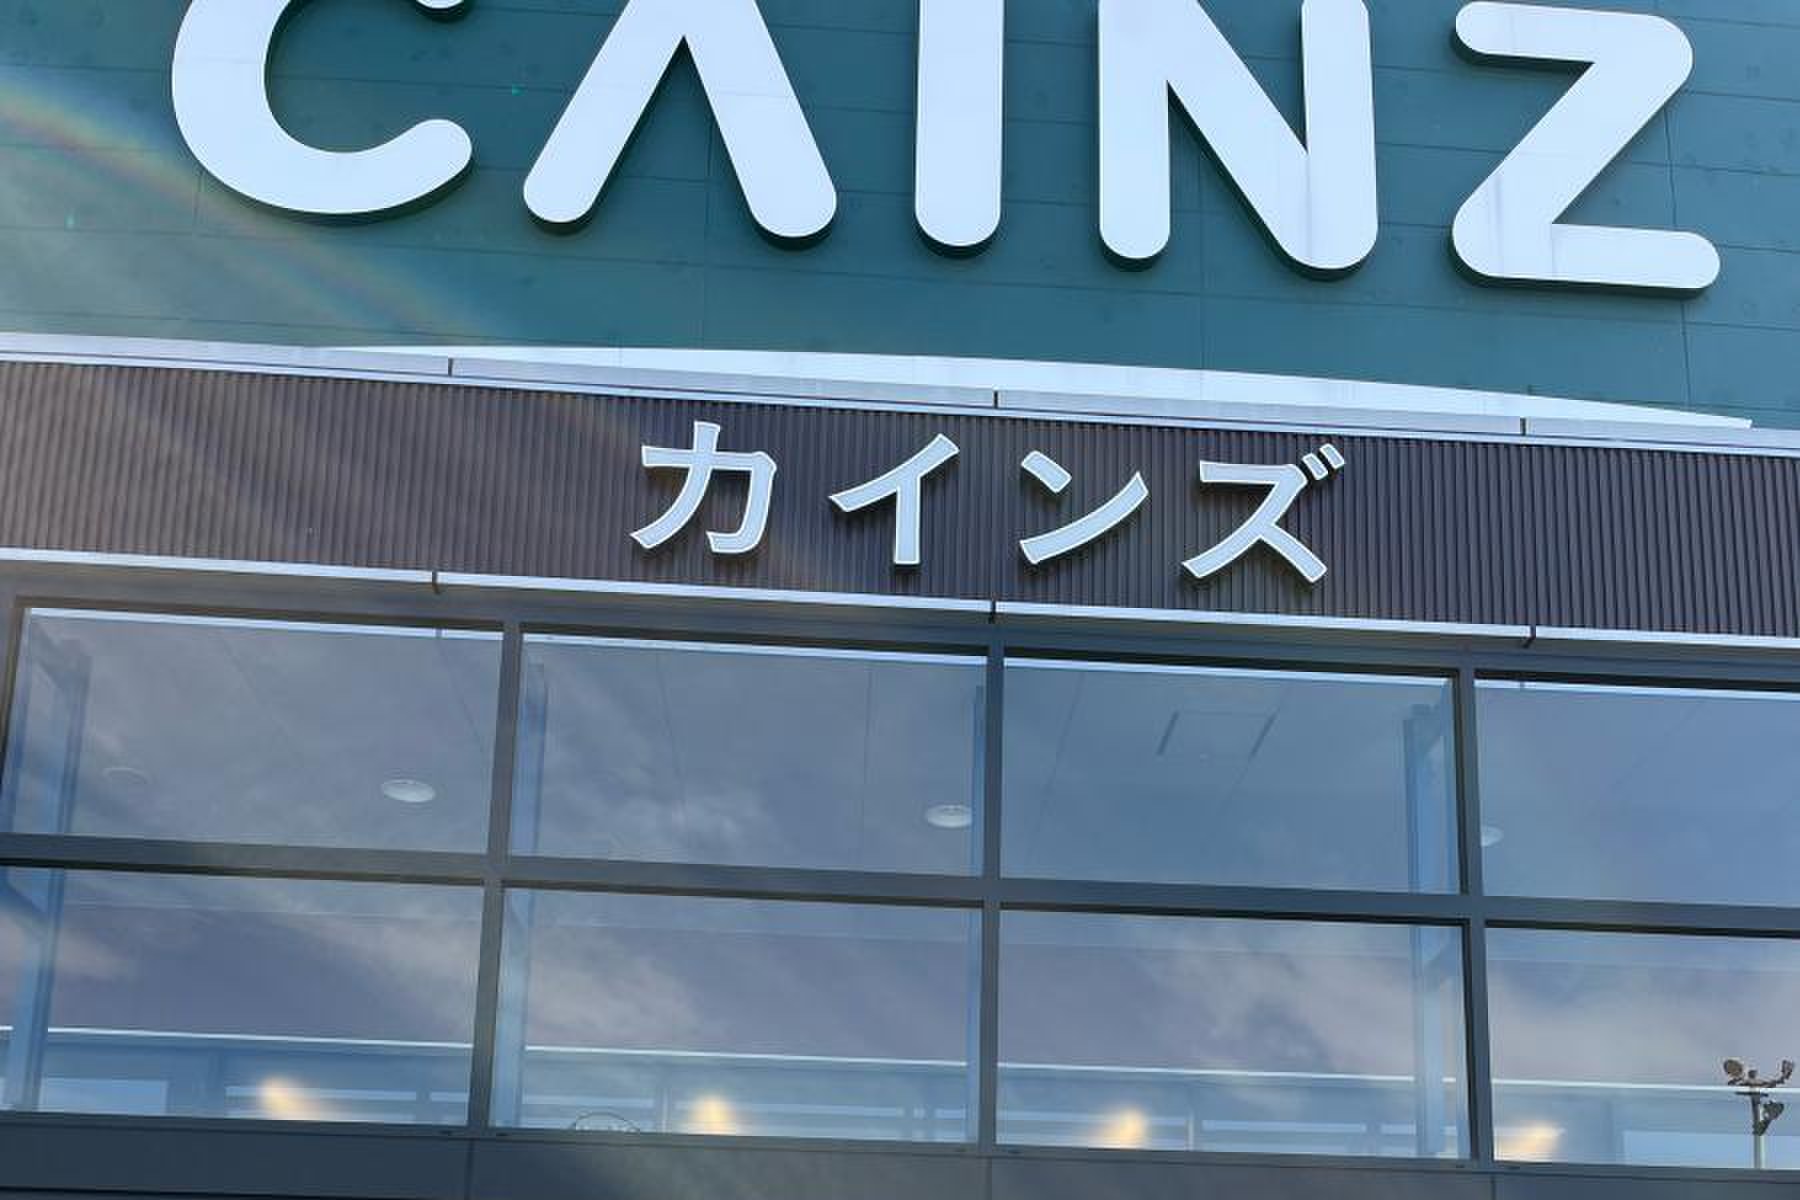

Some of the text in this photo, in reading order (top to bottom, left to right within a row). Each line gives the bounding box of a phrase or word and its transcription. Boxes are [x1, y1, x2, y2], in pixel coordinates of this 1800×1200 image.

[171, 0, 1721, 290] CAINZ
[630, 420, 1346, 584] カインズ
